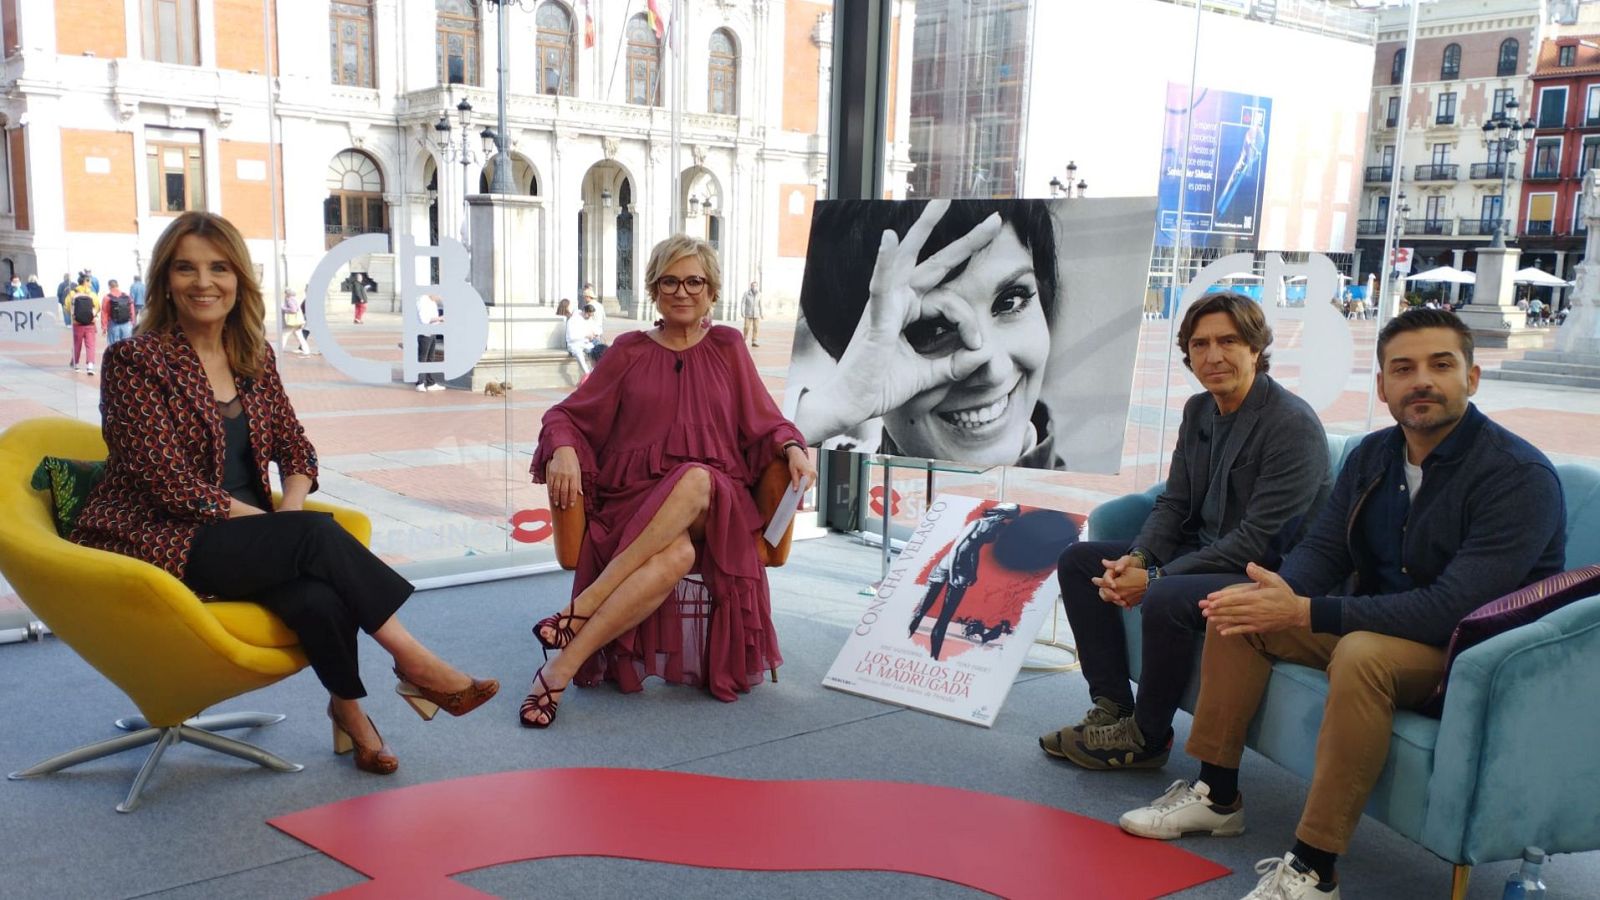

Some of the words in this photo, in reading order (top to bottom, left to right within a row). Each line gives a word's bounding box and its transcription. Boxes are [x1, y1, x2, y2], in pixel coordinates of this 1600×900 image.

[855, 567, 907, 637] CONCHA
[898, 501, 948, 561] VELASCO
[855, 661, 872, 676] LA
[878, 666, 971, 698] MADRUGADA
[864, 650, 890, 666] LOS
[894, 658, 949, 679] GALLOS
[952, 670, 977, 686] DE
